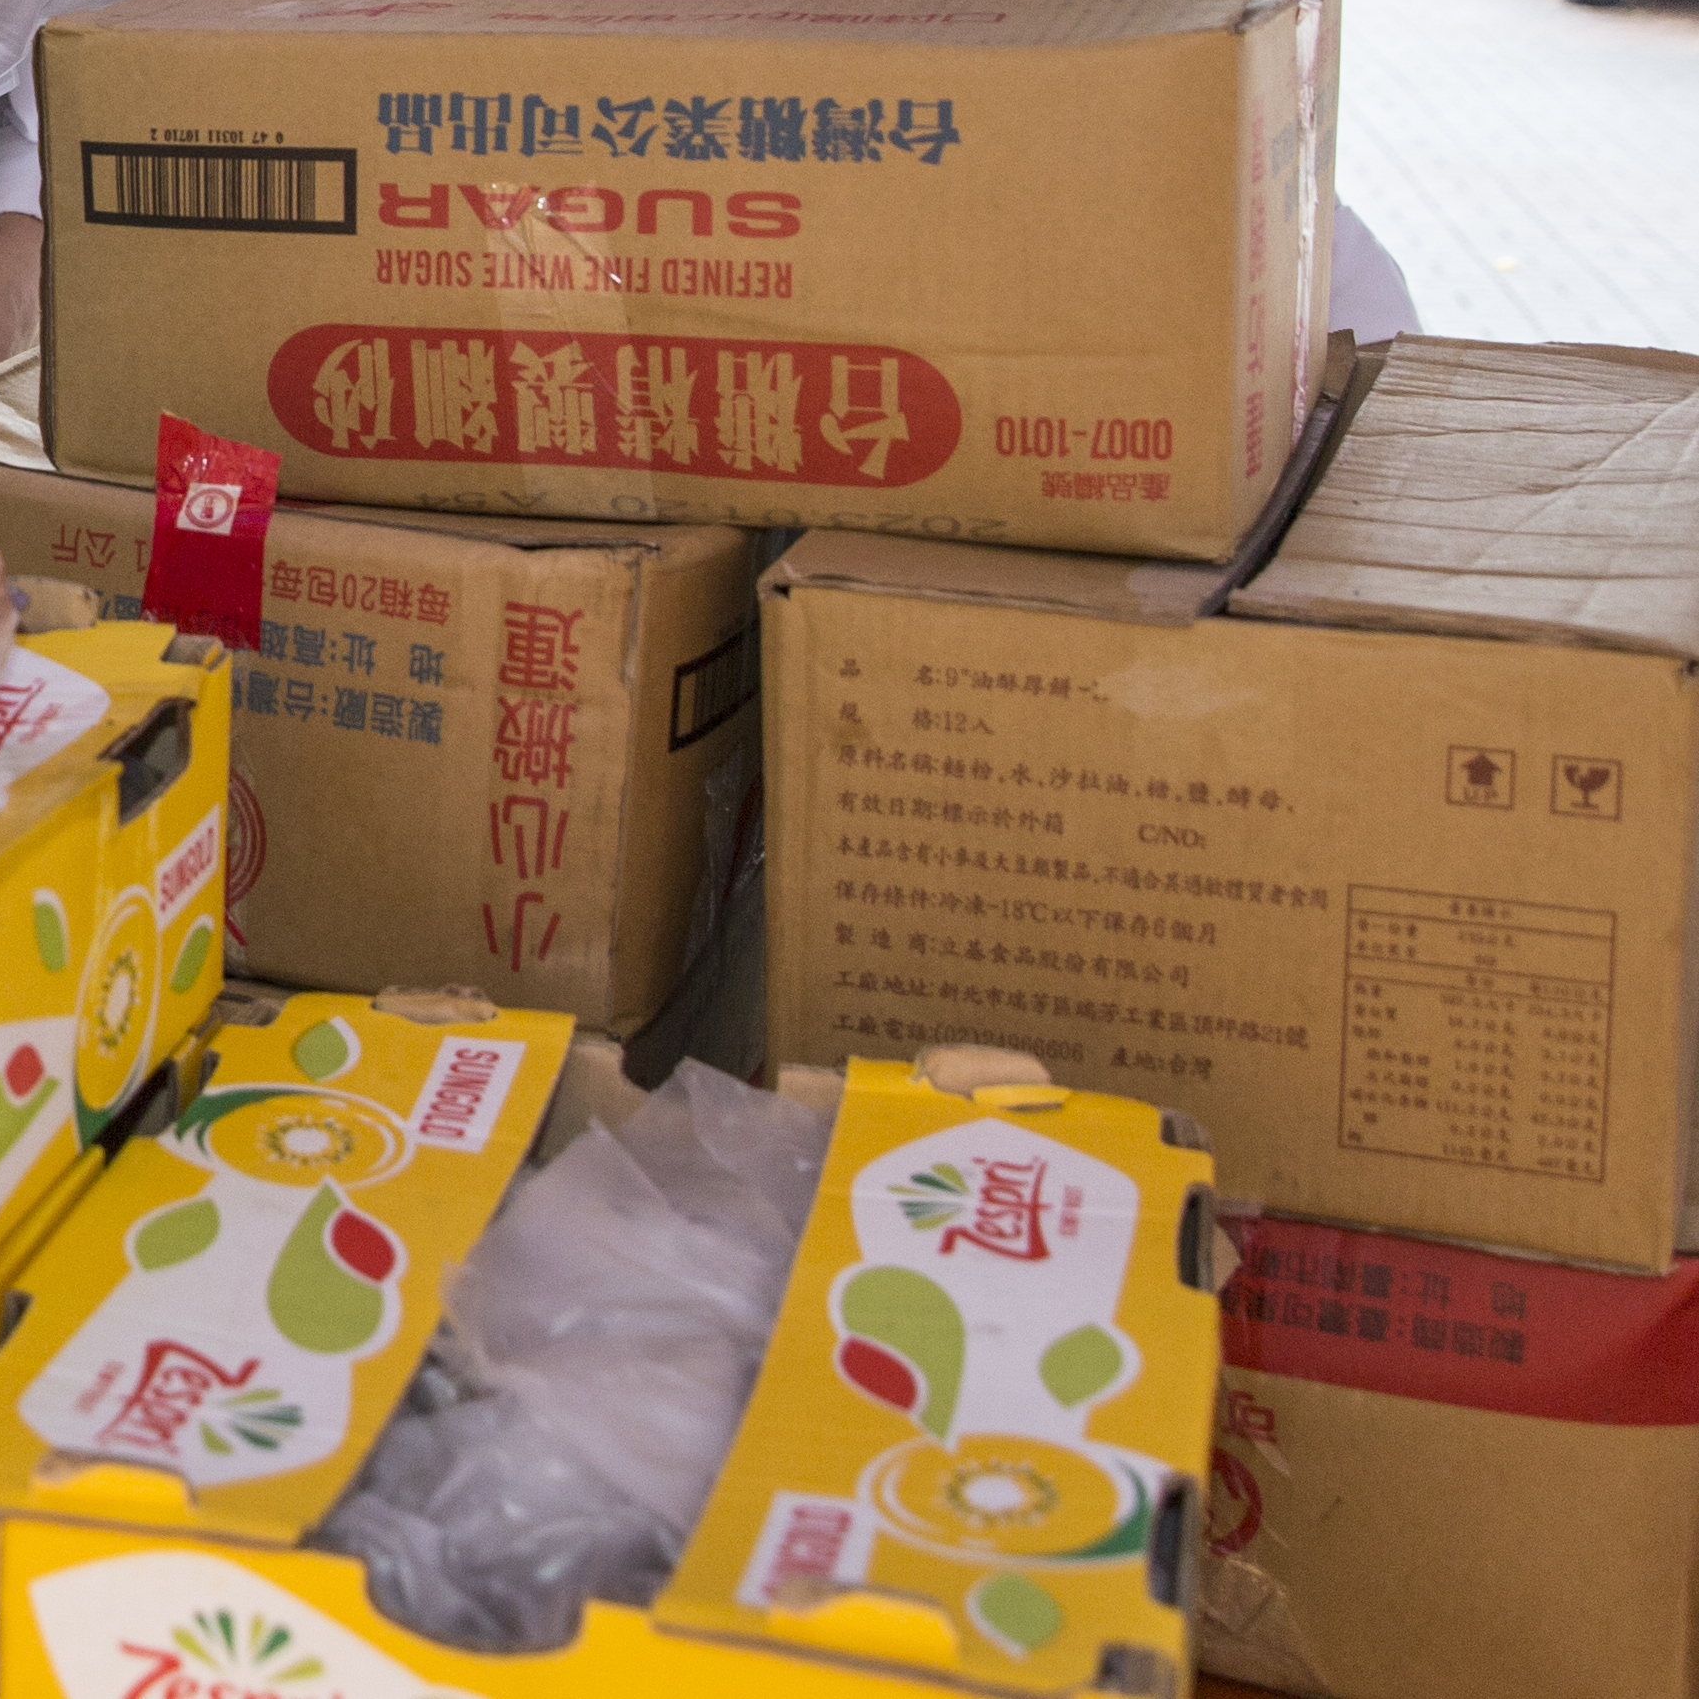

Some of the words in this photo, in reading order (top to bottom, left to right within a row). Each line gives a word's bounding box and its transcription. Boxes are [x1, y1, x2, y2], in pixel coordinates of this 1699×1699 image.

[163, 126, 202, 142] 10710
[207, 127, 246, 144] 10311
[251, 128, 270, 144] 47
[375, 91, 962, 167] 台灣糖業公司出品
[377, 181, 805, 240] SUGAR
[375, 247, 473, 290] SUGAR
[480, 250, 575, 293] WHITE
[584, 252, 652, 294] FINE
[660, 255, 794, 299] REFINED
[310, 335, 912, 483] 台糖精製細砂
[1040, 472, 1171, 502] 產品編號
[229, 667, 444, 747] 製造廠:台灣
[480, 598, 586, 974] 小心搬運
[418, 1047, 500, 1139] SUNGOLD
[937, 1156, 1053, 1262] Zespri
